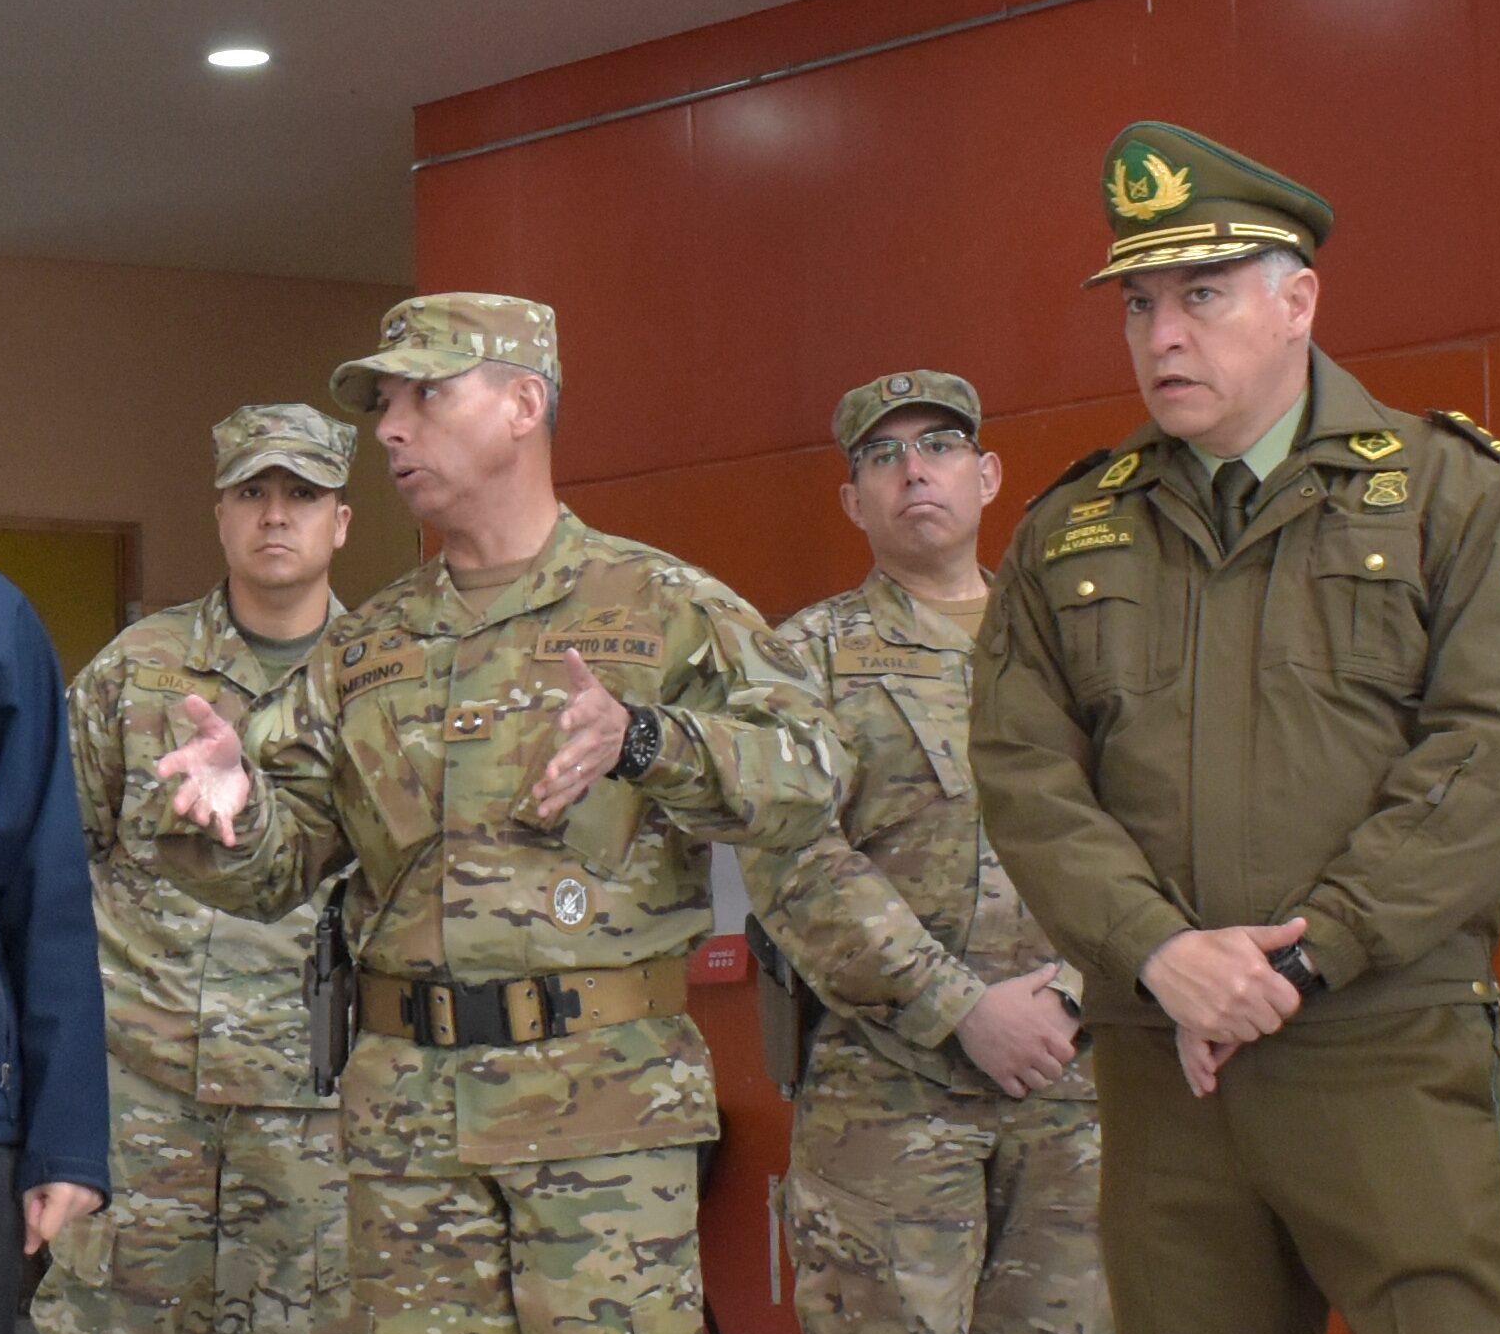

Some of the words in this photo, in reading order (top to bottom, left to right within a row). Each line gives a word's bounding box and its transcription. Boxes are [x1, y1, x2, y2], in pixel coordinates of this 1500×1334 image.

[1060, 534, 1116, 553] ALVARADO
[604, 638, 619, 653] DE
[623, 639, 656, 658] CHILE
[157, 674, 196, 693] DIAZ
[341, 662, 404, 698] MERINO
